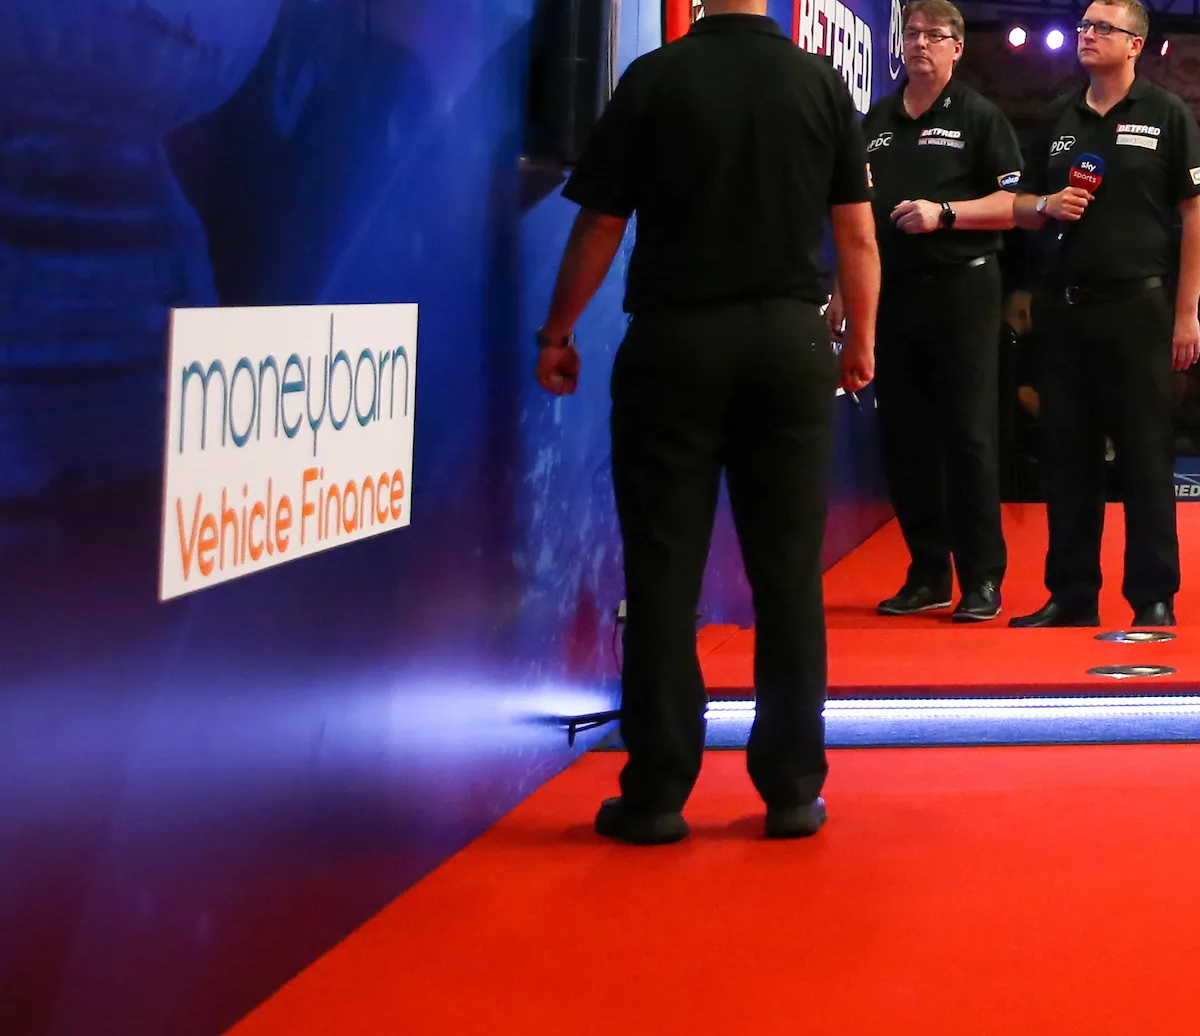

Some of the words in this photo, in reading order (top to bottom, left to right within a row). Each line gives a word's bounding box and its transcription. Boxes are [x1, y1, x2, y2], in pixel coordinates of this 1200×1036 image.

[922, 128, 961, 138] BETFRED
[1117, 124, 1161, 136] BETFRED
[1051, 140, 1073, 153] PDC
[1080, 160, 1096, 173] sky
[1073, 170, 1097, 184] sports
[179, 313, 409, 457] moneybarn
[176, 477, 293, 582] Vehicle
[300, 467, 405, 546] Finance
